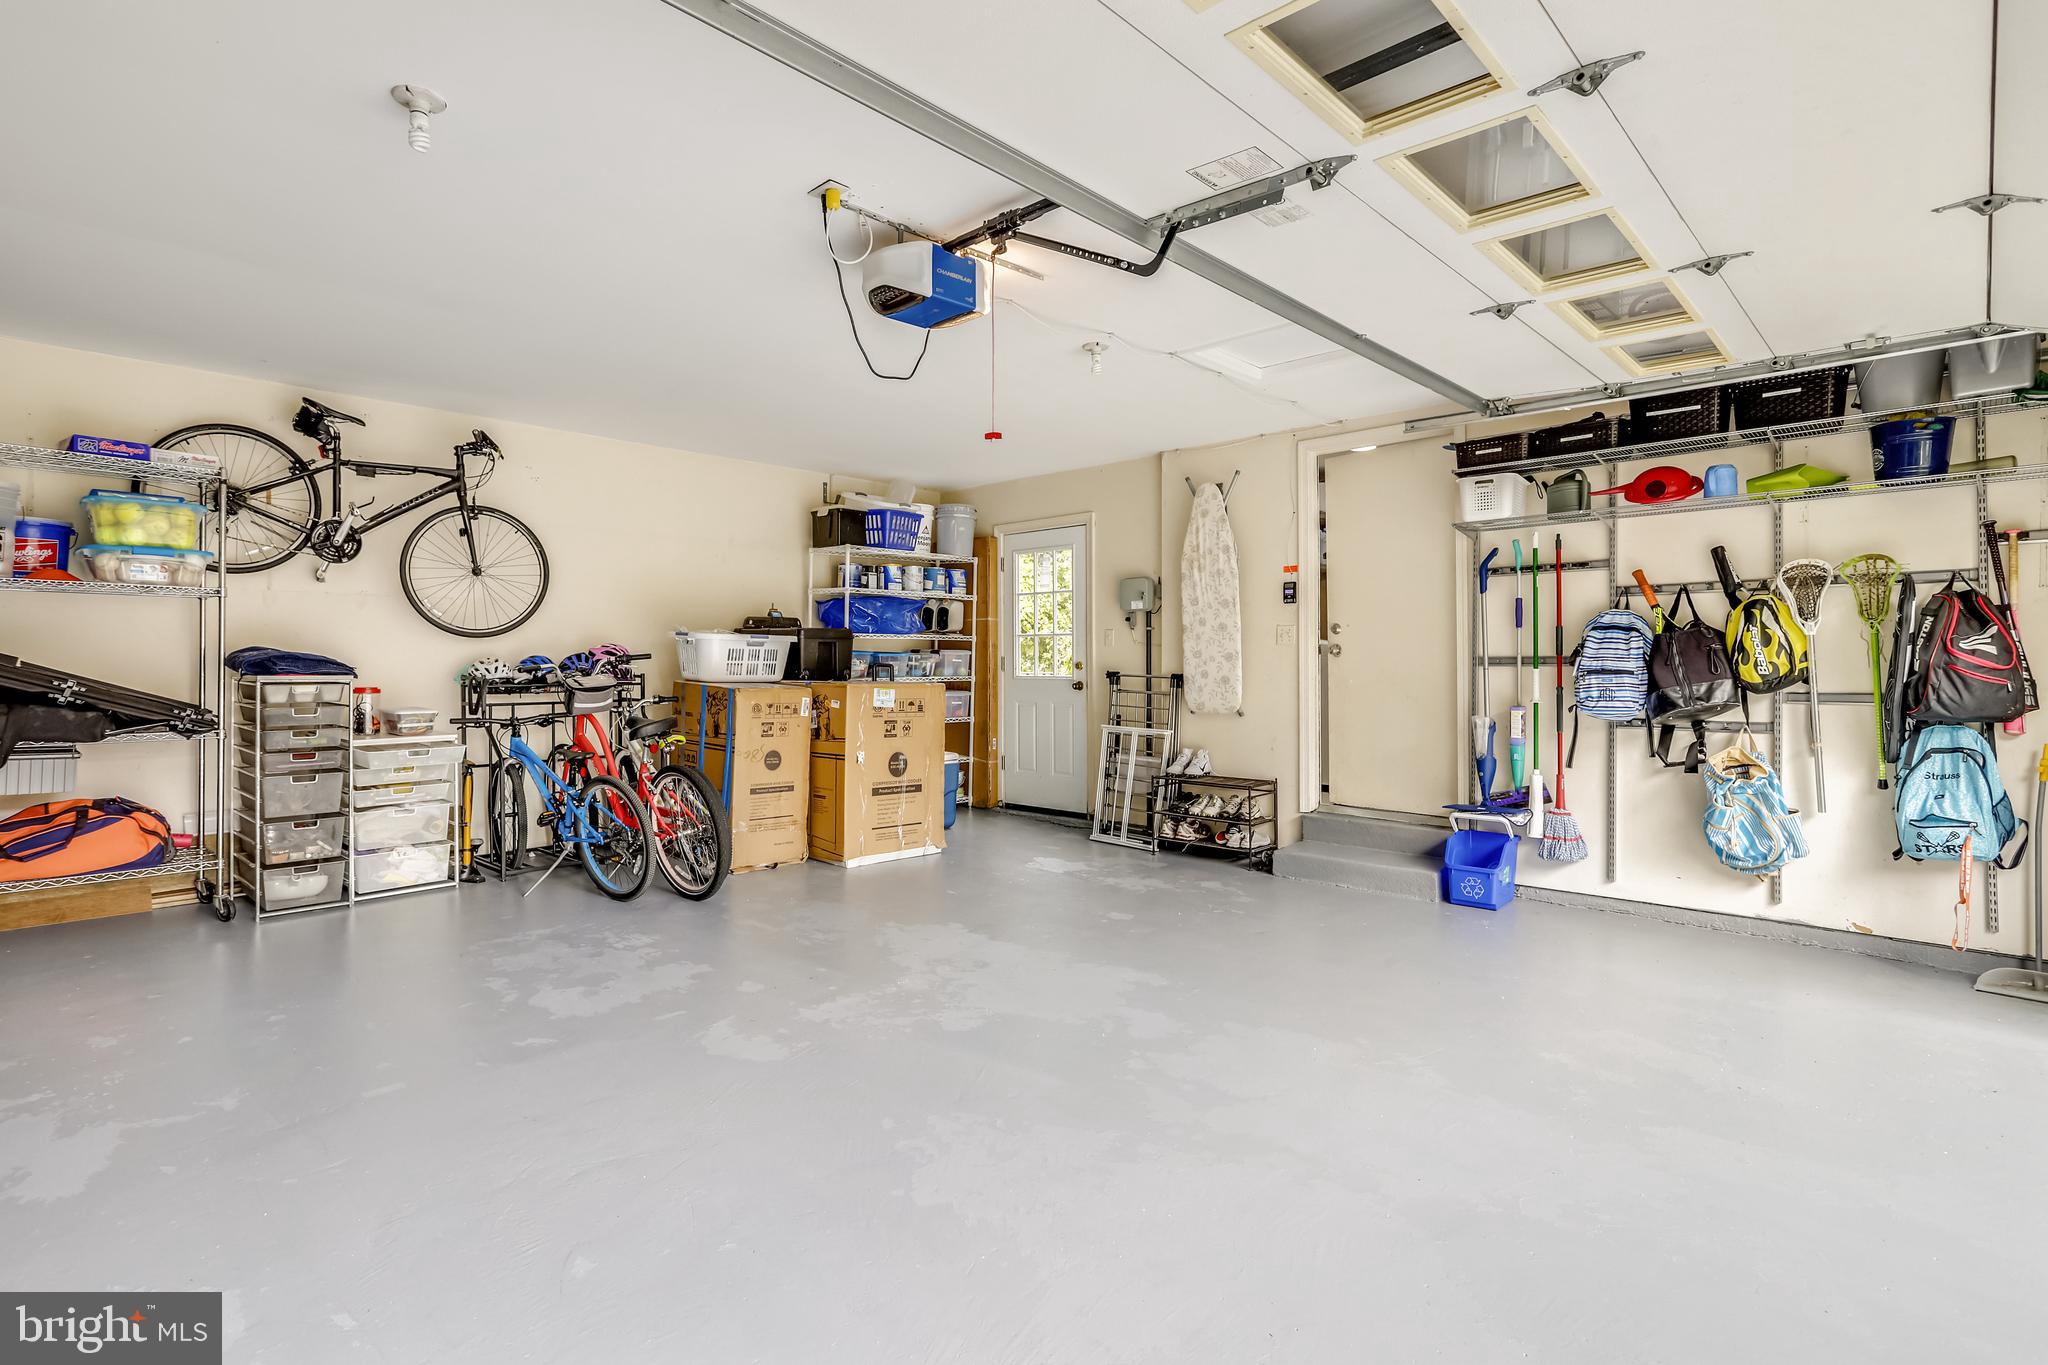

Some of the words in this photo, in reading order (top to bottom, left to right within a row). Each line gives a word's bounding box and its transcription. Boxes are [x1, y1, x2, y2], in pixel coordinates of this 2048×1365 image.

[936, 267, 973, 284] CHAMBERLAIN
[14, 545, 54, 561] wlings
[1924, 771, 1961, 780] Strauss
